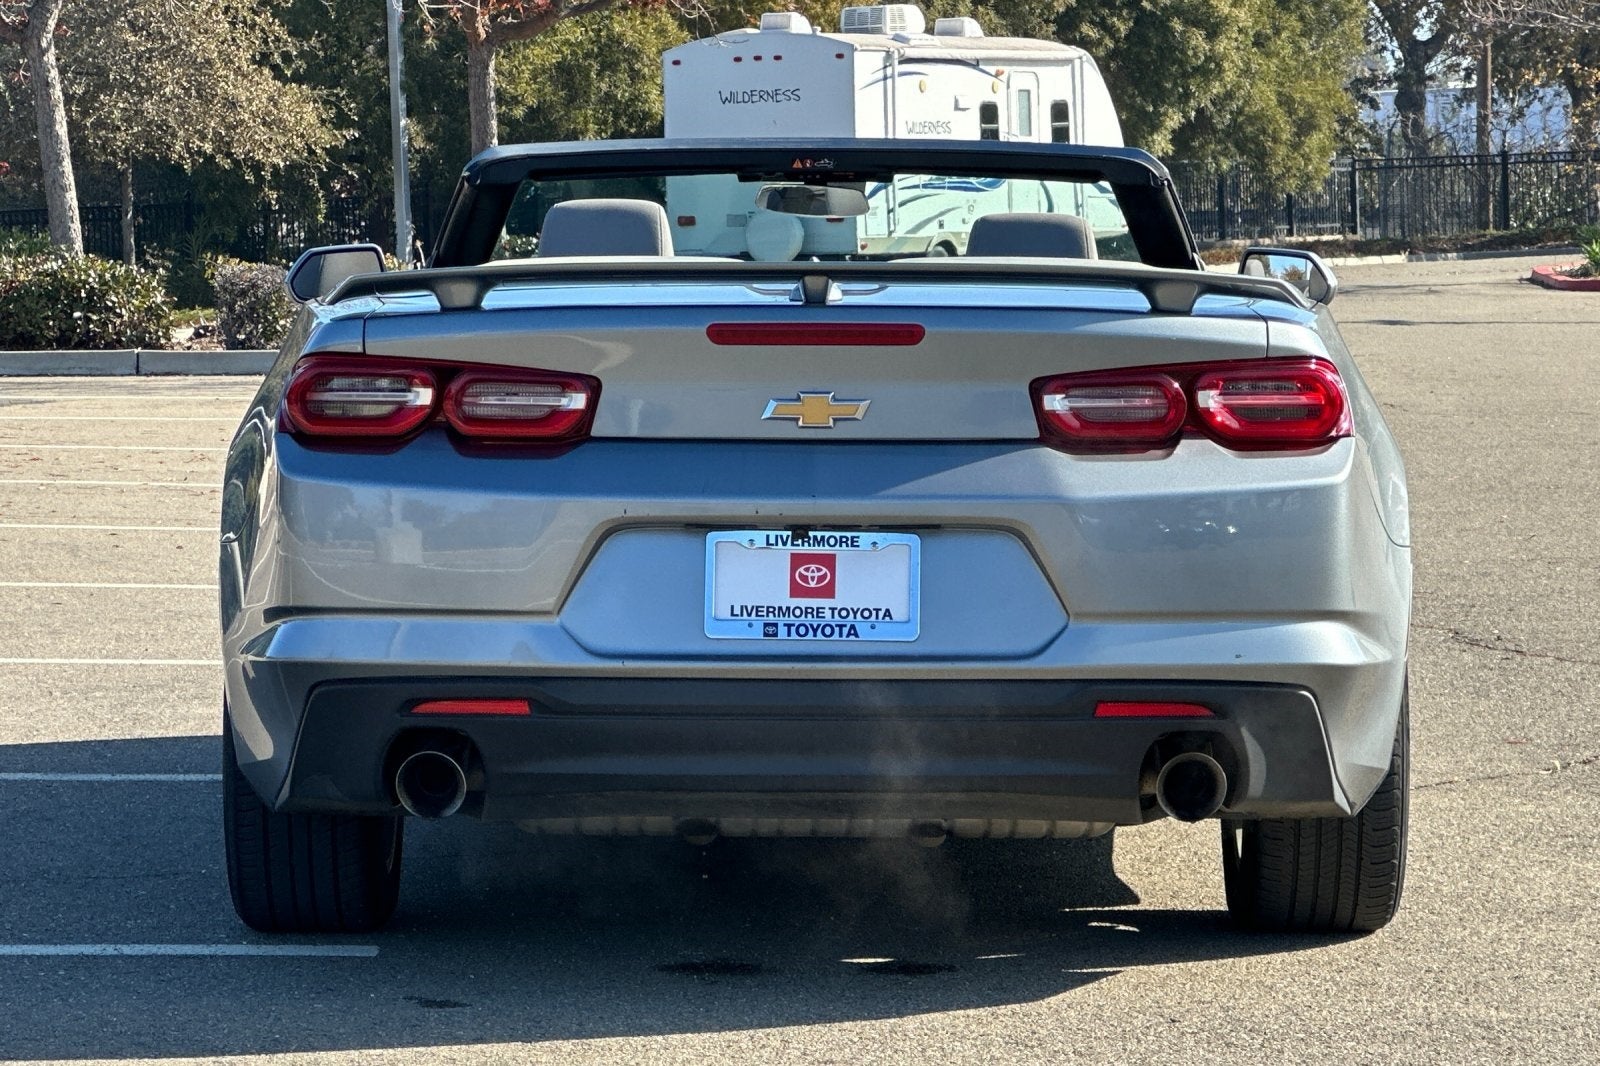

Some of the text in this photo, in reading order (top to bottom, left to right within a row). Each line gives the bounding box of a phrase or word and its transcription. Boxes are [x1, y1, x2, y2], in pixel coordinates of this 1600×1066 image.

[719, 88, 801, 105] WILDERNESS
[906, 120, 951, 135] WILDERNESS
[765, 534, 860, 548] LIVERMORE
[730, 604, 893, 620] LIVERMORE TOYOTA
[783, 623, 859, 638] TOYOTA
